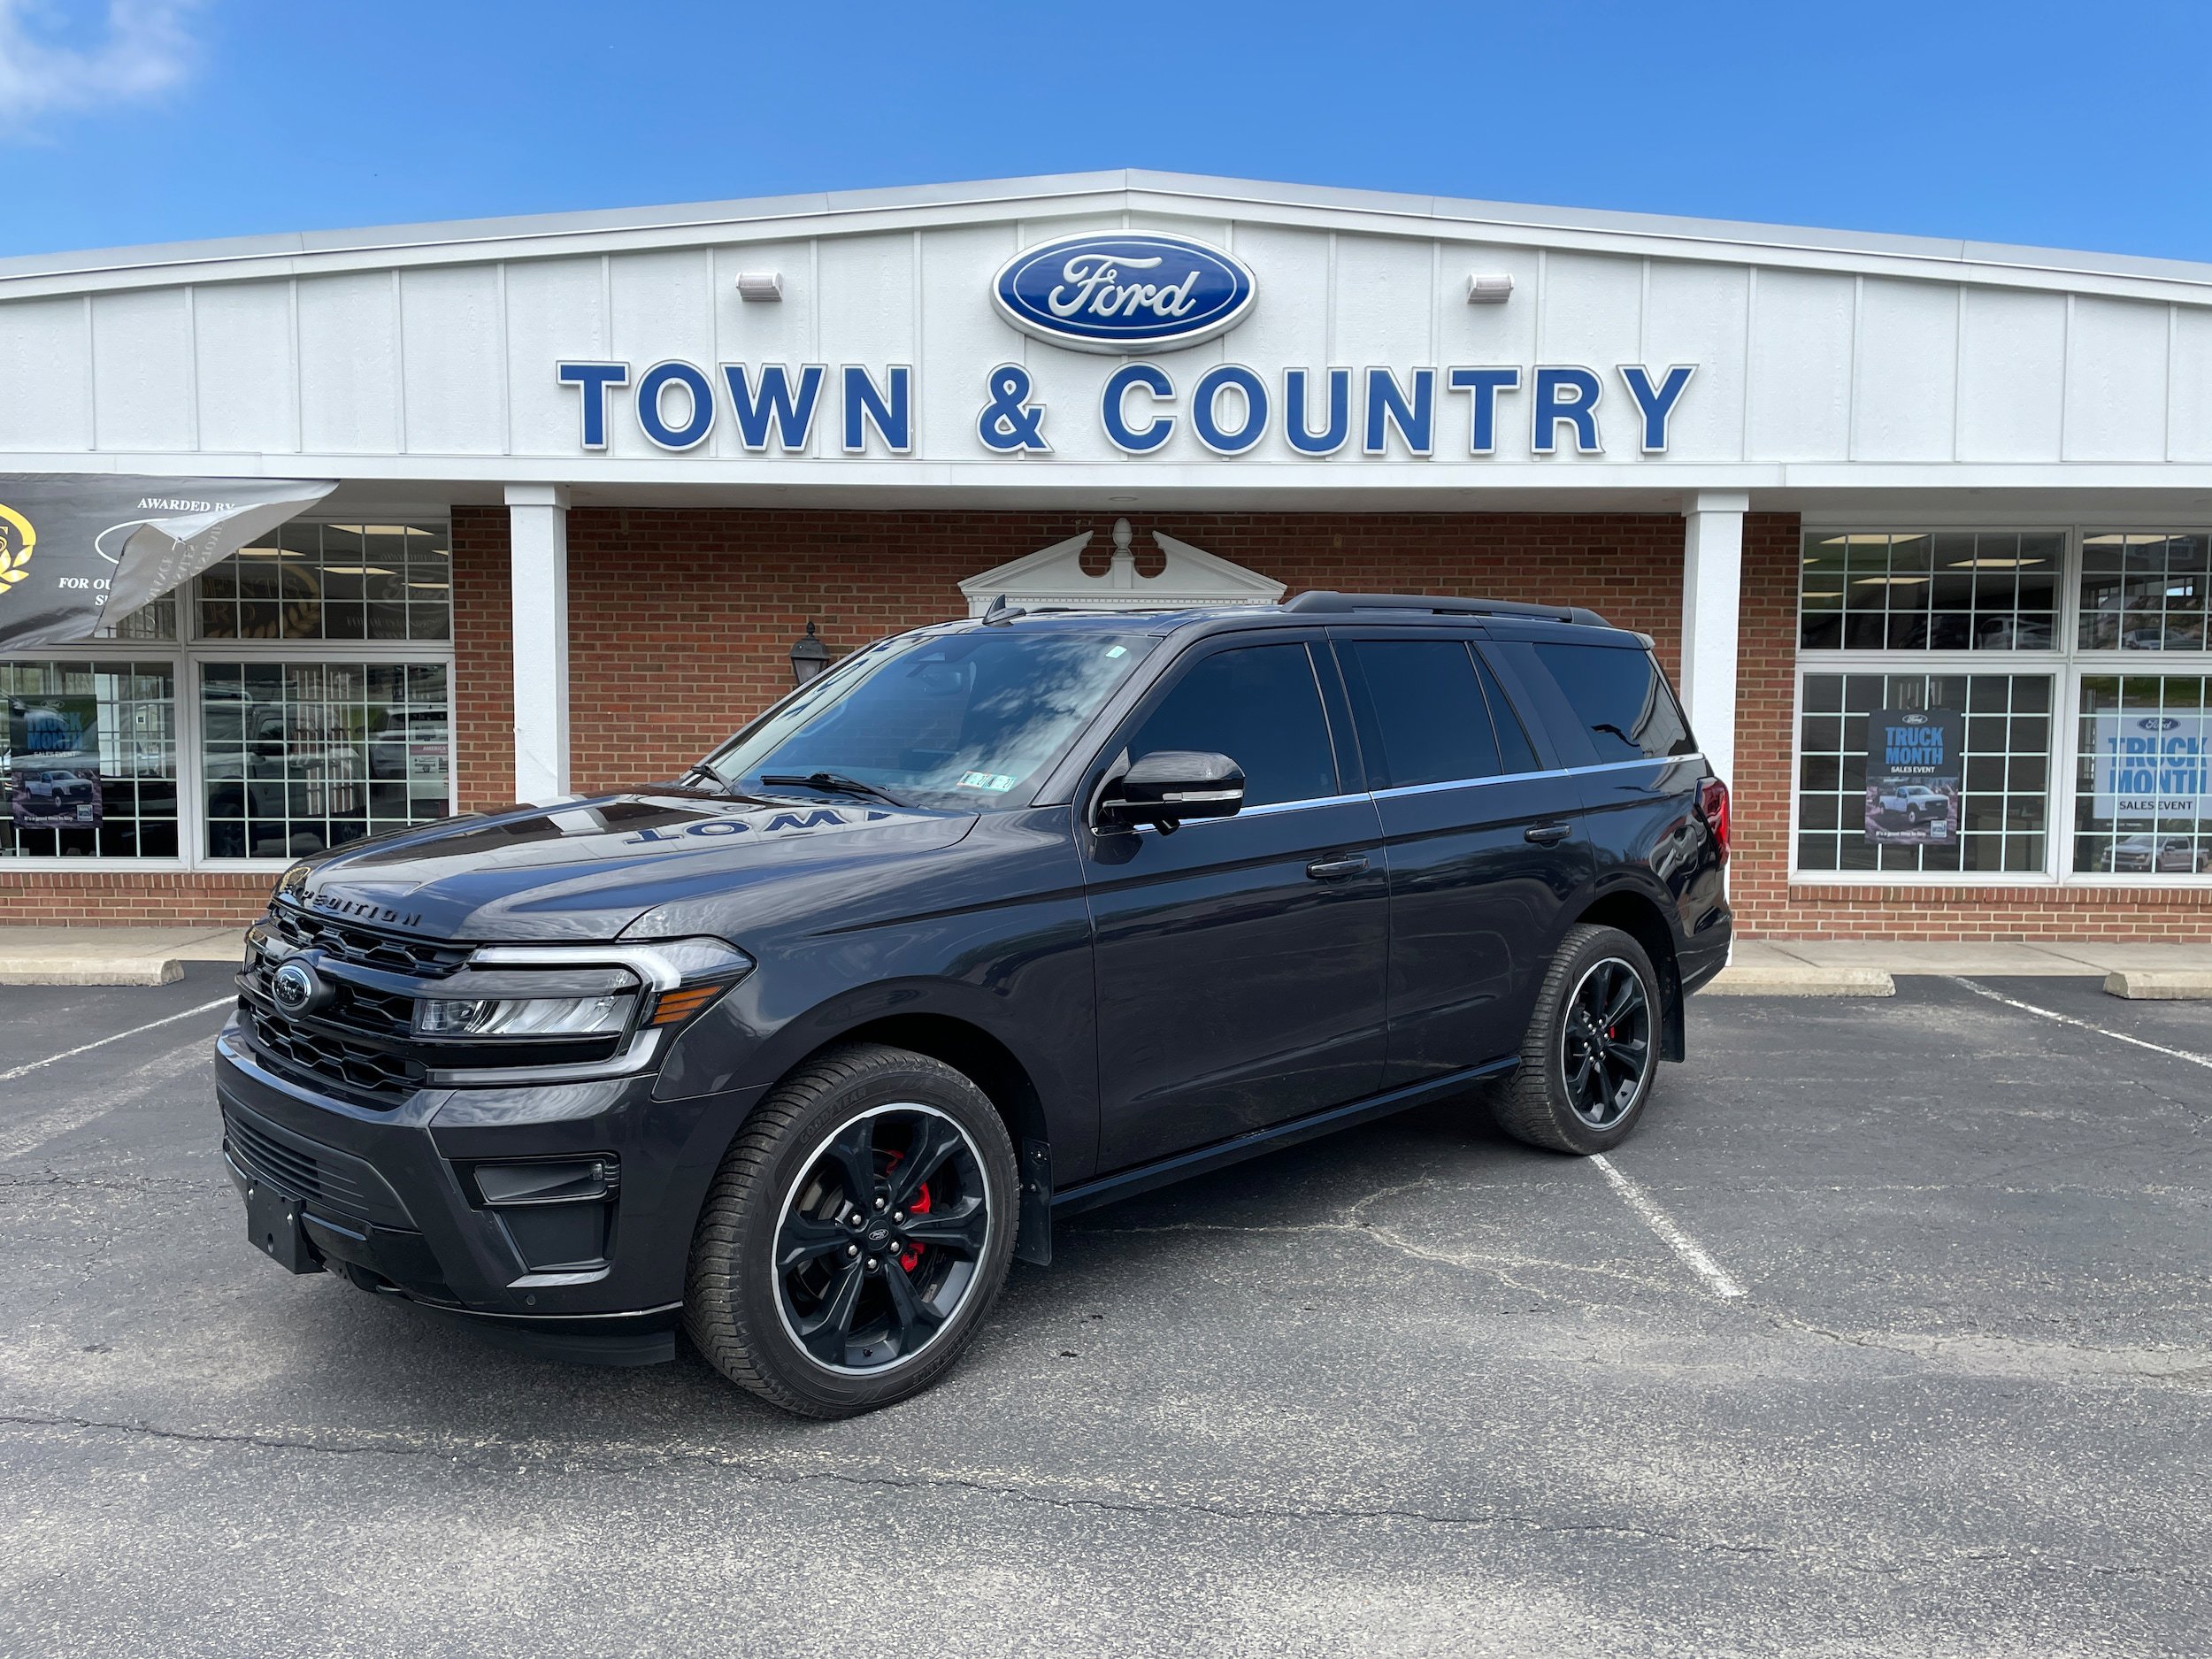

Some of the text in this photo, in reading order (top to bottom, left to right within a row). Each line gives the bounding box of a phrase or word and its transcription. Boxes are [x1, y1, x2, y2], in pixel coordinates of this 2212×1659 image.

[1048, 253, 1202, 319] Ford
[556, 358, 1700, 457] TOWN & COUNTRY
[137, 497, 211, 512] AWARDED
[58, 577, 89, 589] FOR
[27, 711, 83, 732] TRUCK
[27, 732, 84, 750] MONTH
[1885, 726, 1944, 747] TRUCK
[1885, 747, 1944, 765] MONTH
[2108, 736, 2208, 768] TRUCK
[2108, 769, 2208, 795] MONTH
[2119, 800, 2193, 810] SALES EVENT
